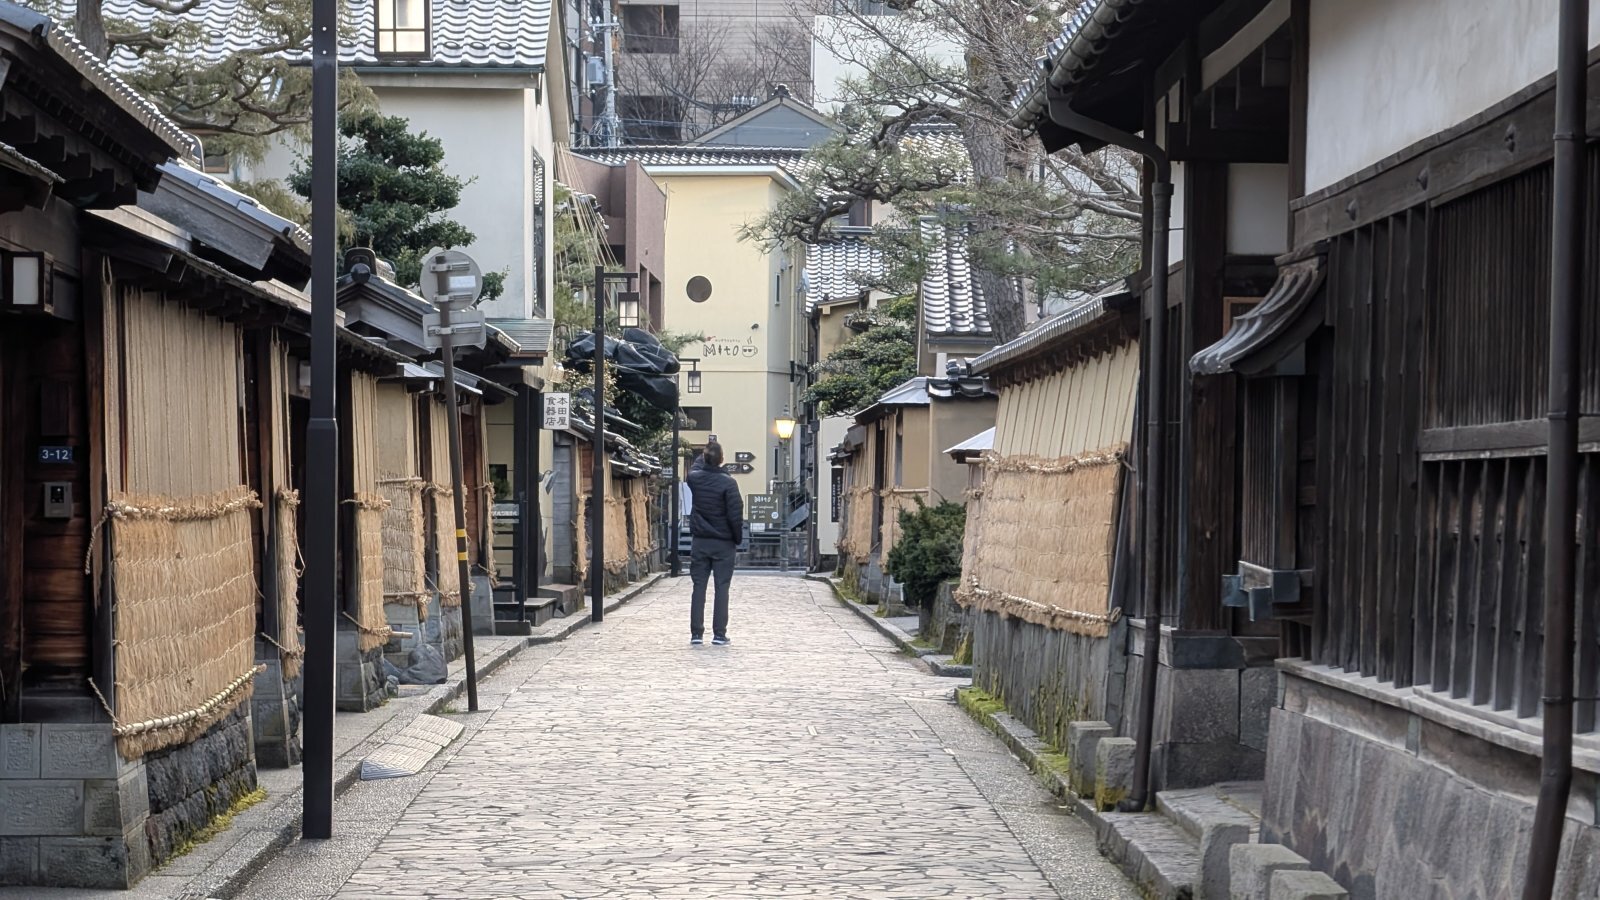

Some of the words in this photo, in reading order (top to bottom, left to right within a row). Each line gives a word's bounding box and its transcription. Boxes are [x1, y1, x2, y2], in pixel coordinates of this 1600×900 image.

[545, 396, 557, 426] 食器店
[556, 396, 568, 426] 本田屋
[42, 449, 69, 460] 3-12
